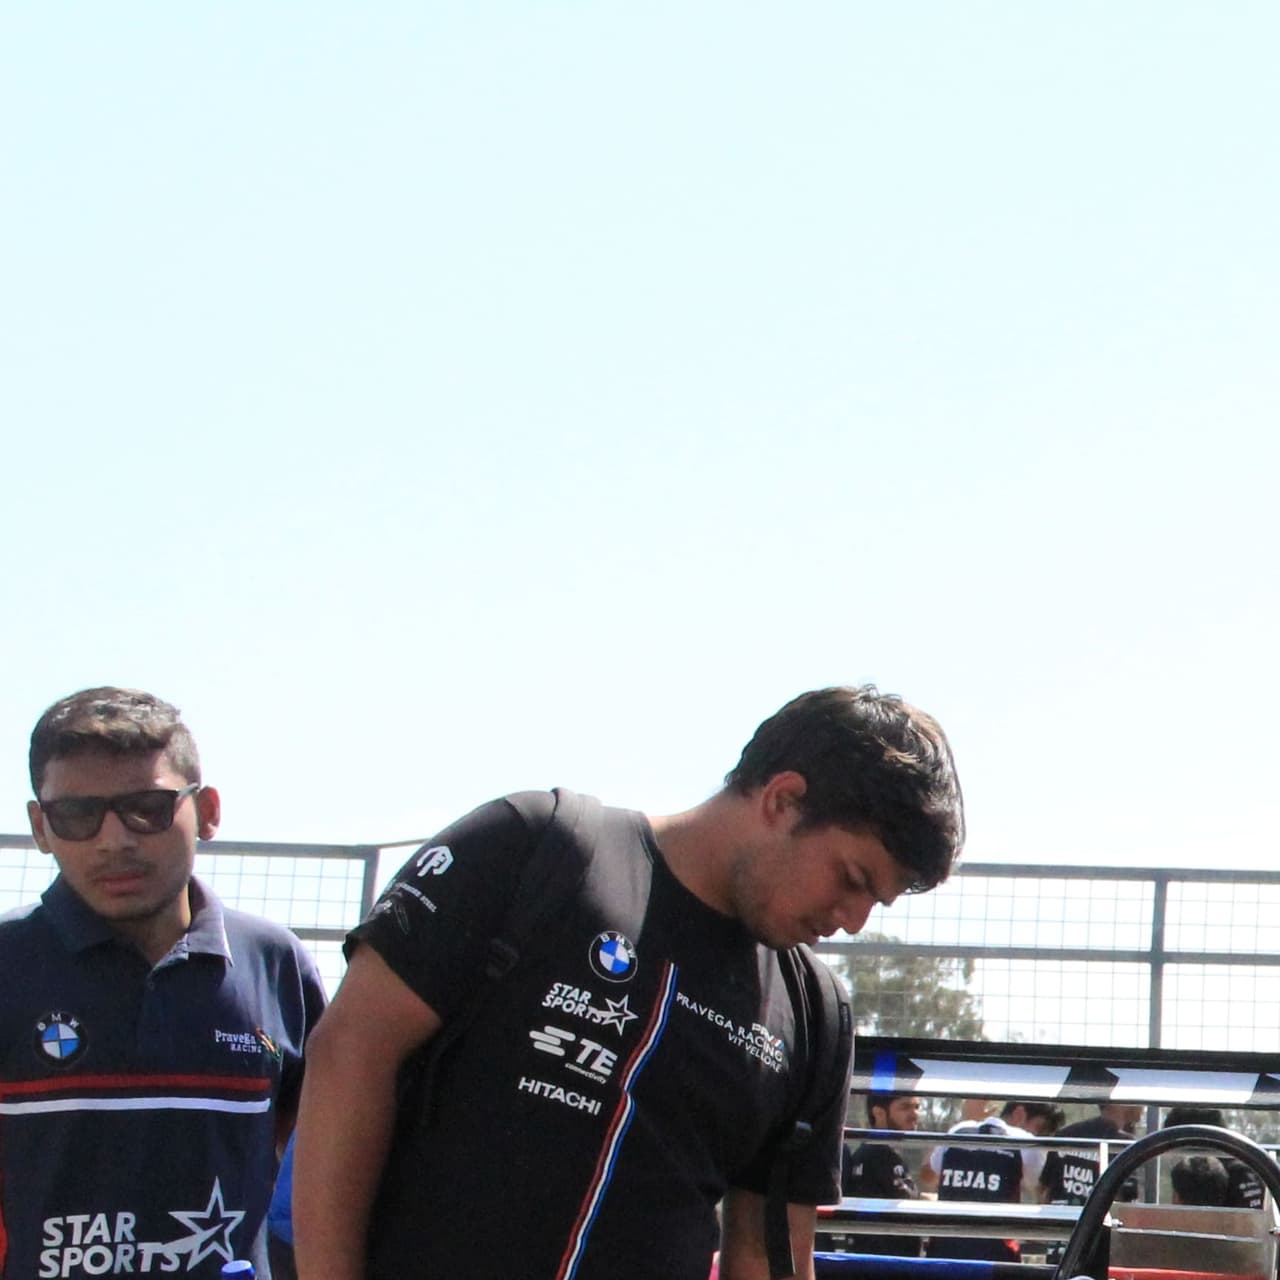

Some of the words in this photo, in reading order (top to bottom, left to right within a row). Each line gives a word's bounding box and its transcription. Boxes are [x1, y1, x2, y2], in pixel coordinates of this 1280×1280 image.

[541, 995, 609, 1025] SPORTS
[549, 983, 593, 1004] STAR
[676, 992, 734, 1031] PRAVEGA
[738, 1026, 783, 1062] RACING
[573, 1038, 618, 1076] TE
[728, 1032, 745, 1047] VIT
[745, 1042, 782, 1073] VELLORE
[518, 1077, 602, 1116] HITACHI
[942, 1168, 1002, 1192] TEJAS
[42, 1211, 137, 1247] STAR
[38, 1241, 182, 1280] SPORTS
